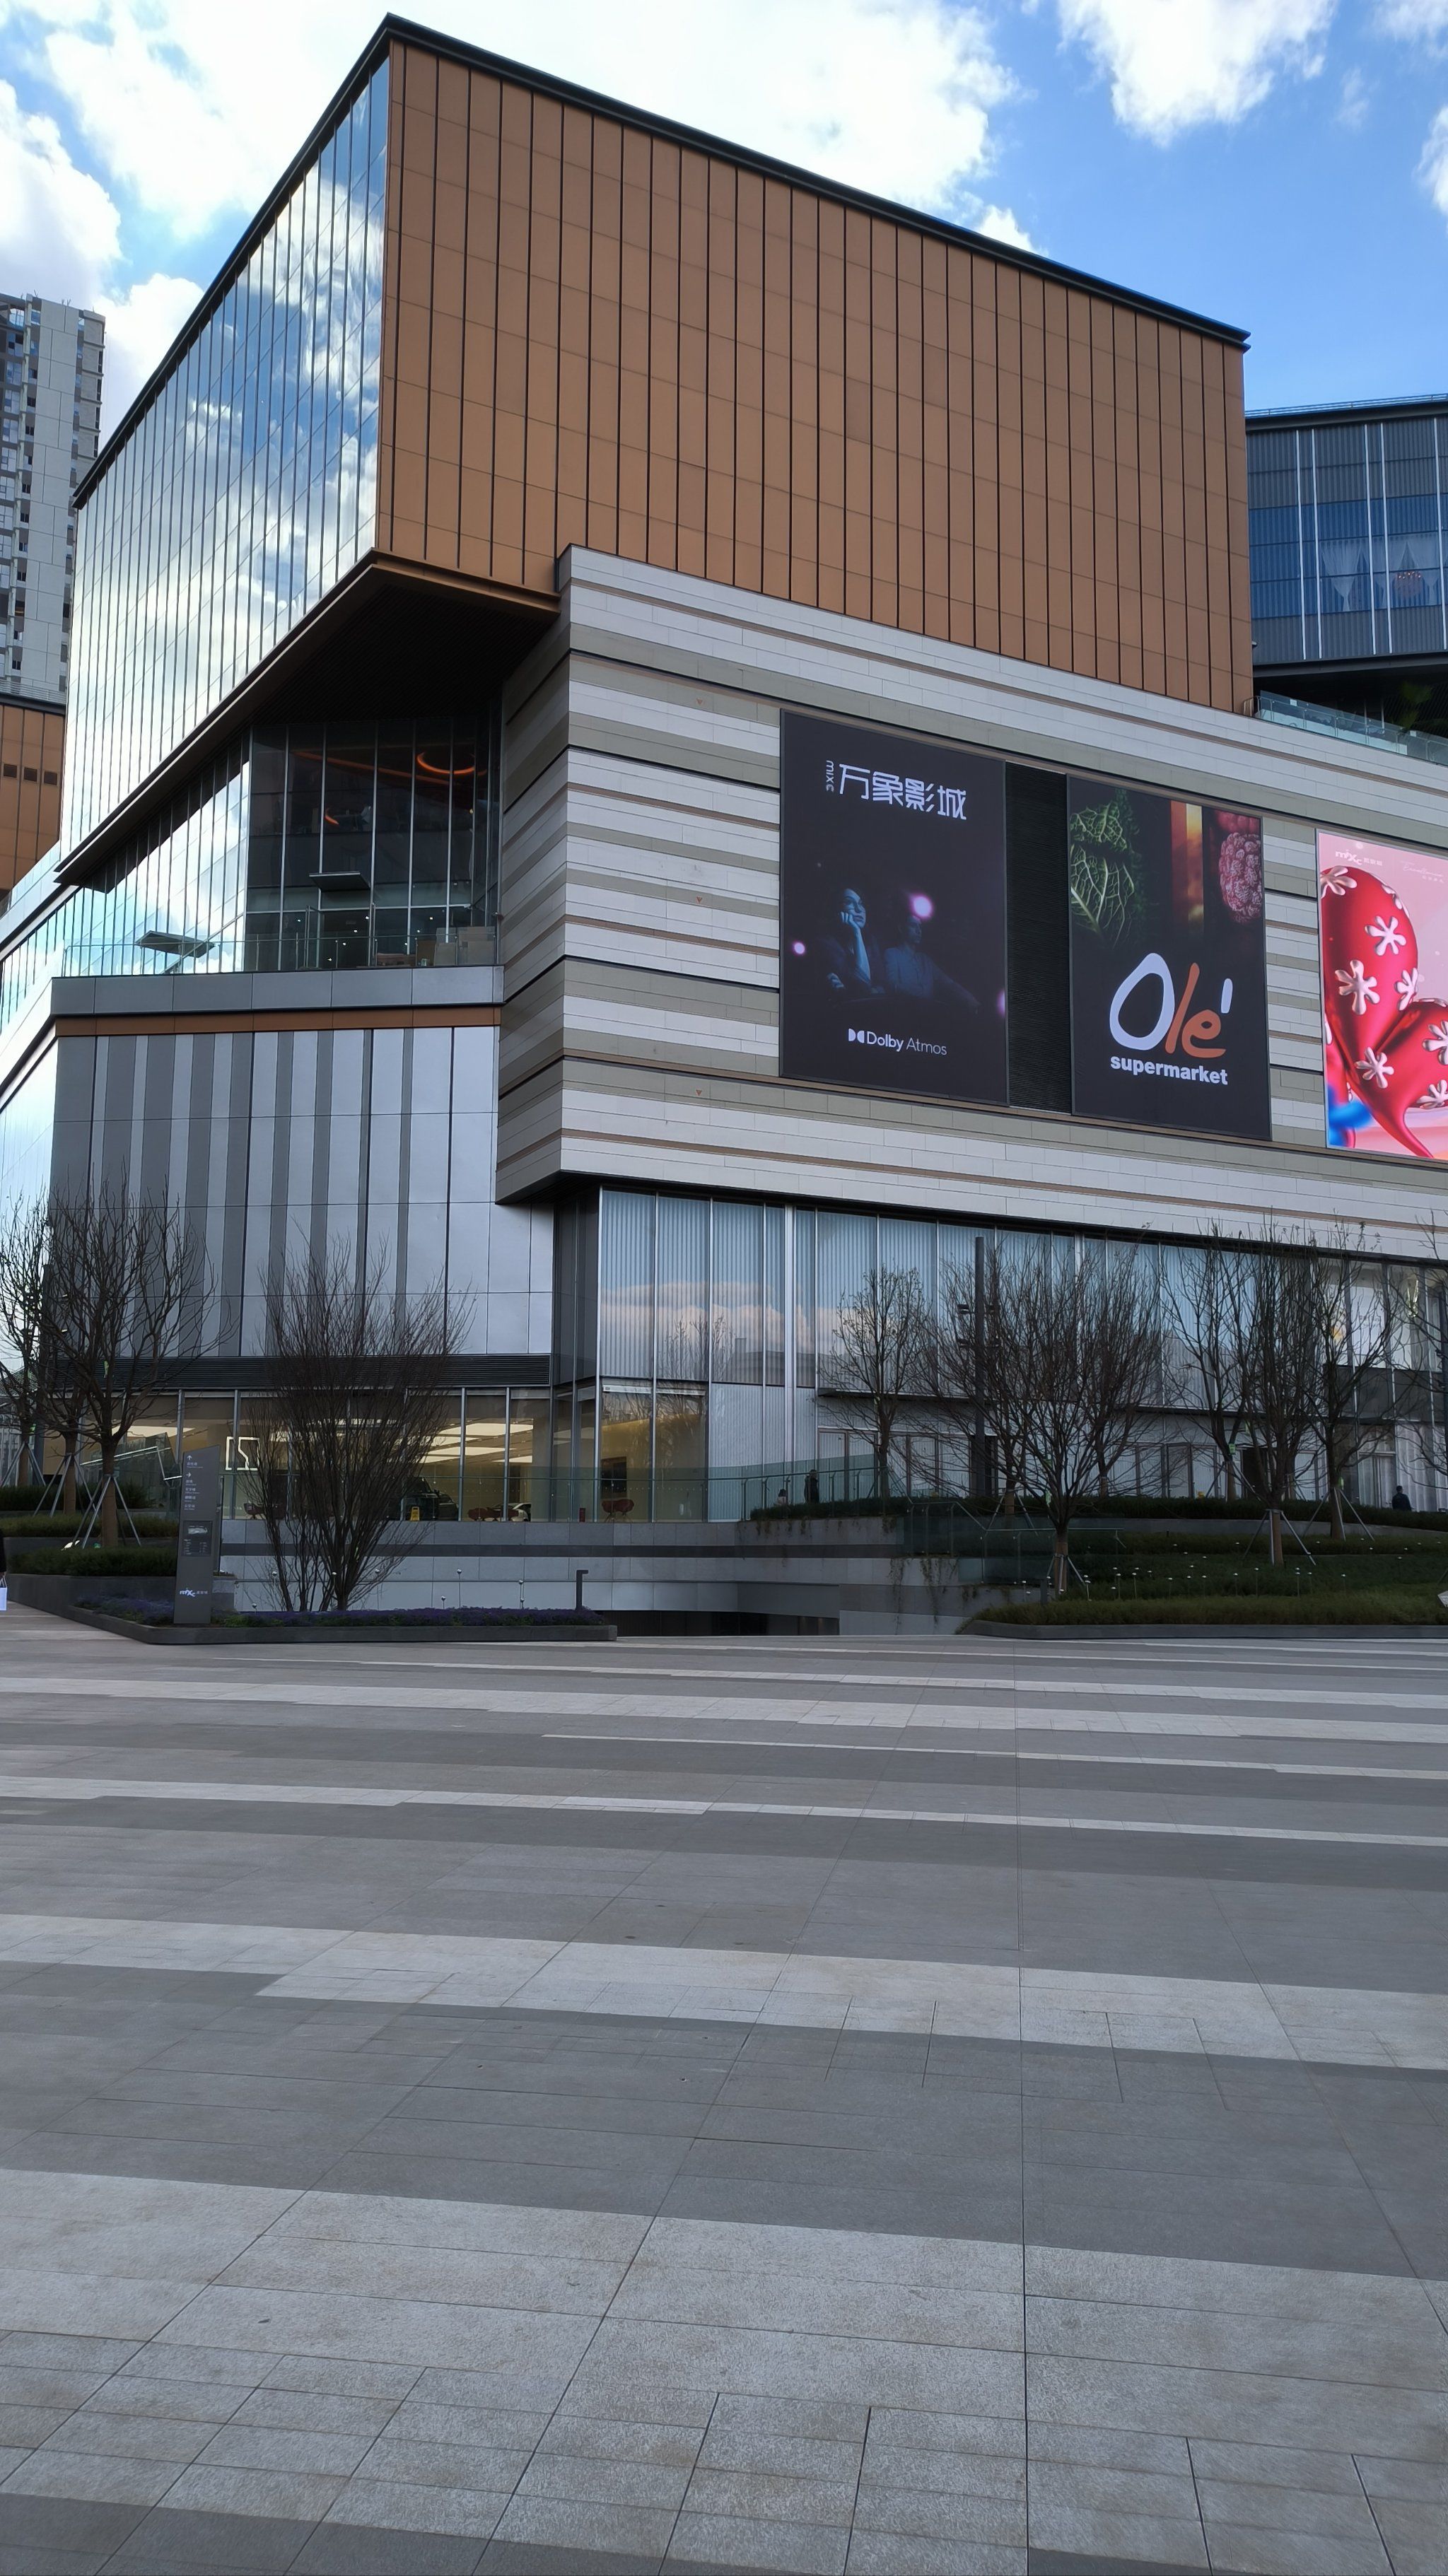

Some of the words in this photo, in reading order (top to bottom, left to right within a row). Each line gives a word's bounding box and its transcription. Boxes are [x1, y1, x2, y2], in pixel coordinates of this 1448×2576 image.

[839, 763, 967, 821] 万象影城
[866, 1031, 904, 1053] Dolby
[906, 1037, 948, 1056] Atmos
[1110, 1055, 1229, 1086] supermarket
